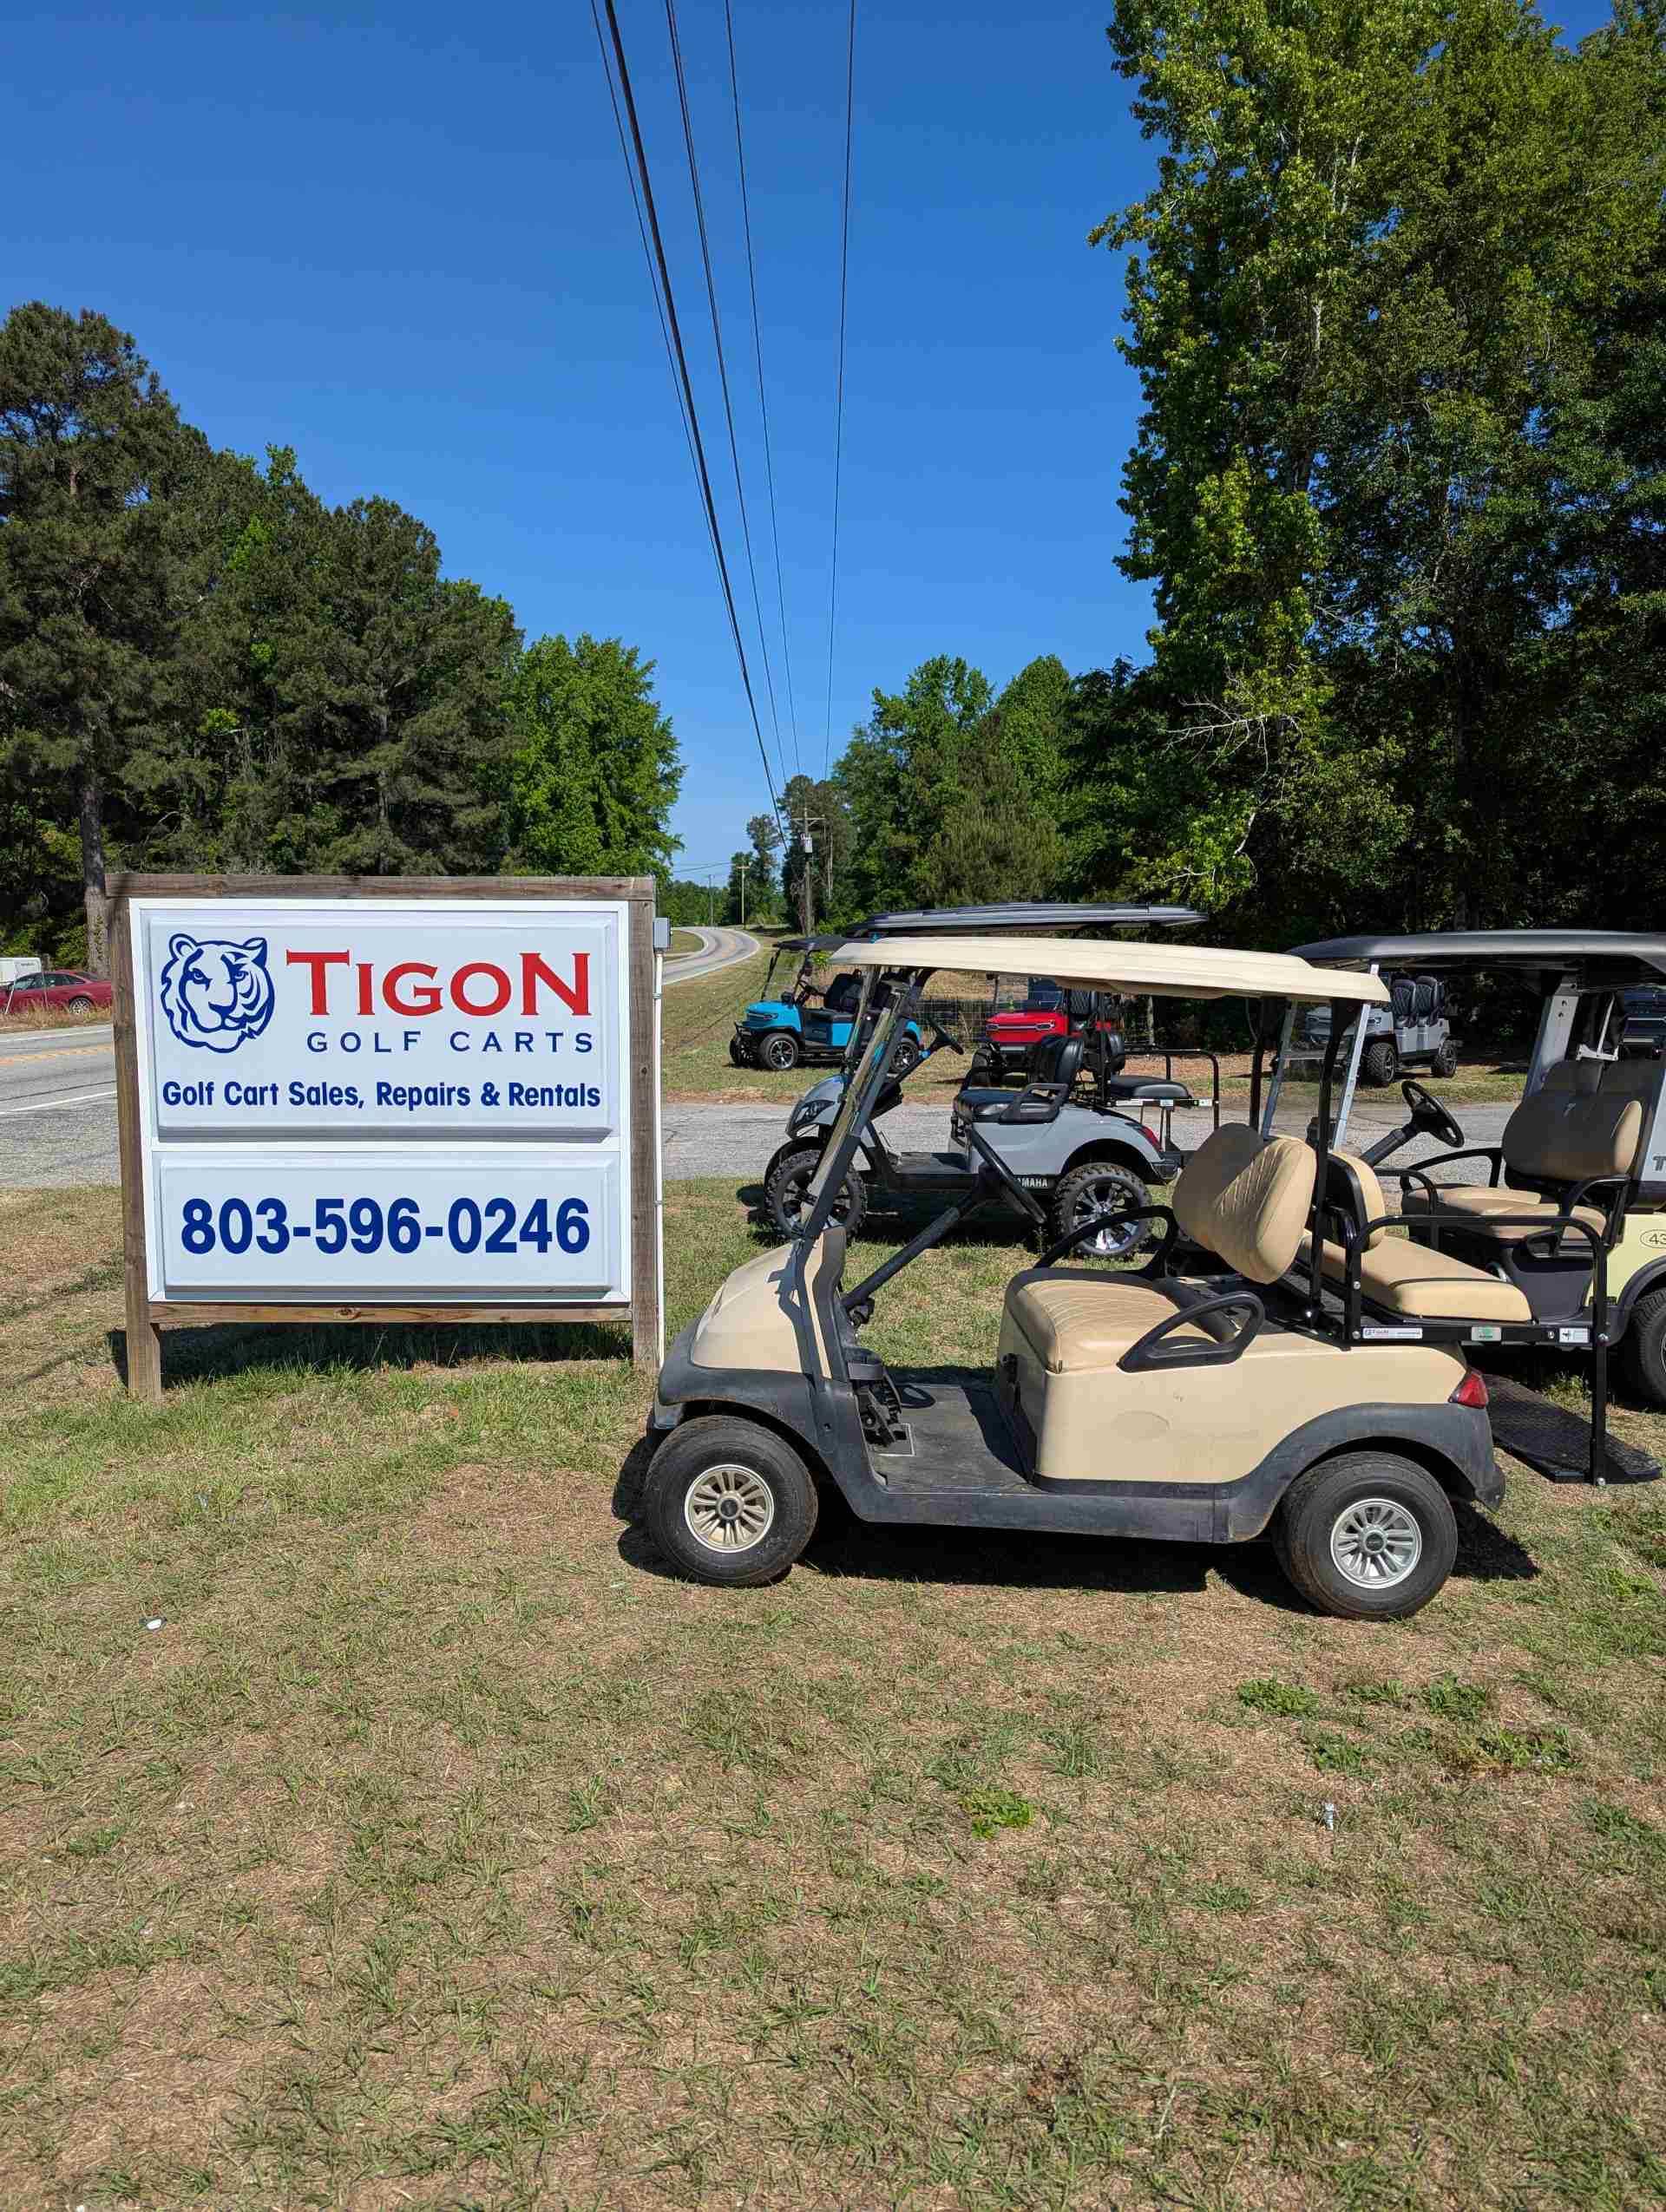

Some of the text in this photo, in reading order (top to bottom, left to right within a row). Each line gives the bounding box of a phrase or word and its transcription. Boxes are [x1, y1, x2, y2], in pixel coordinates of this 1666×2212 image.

[285, 950, 590, 1017] TIGON
[306, 1031, 594, 1054] GOLF CARTS
[162, 1080, 601, 1112] Golf Cart Sales, Repairs & Rentals
[1016, 1177, 1048, 1188] MAHA
[180, 1197, 591, 1255] 803-596-0246
